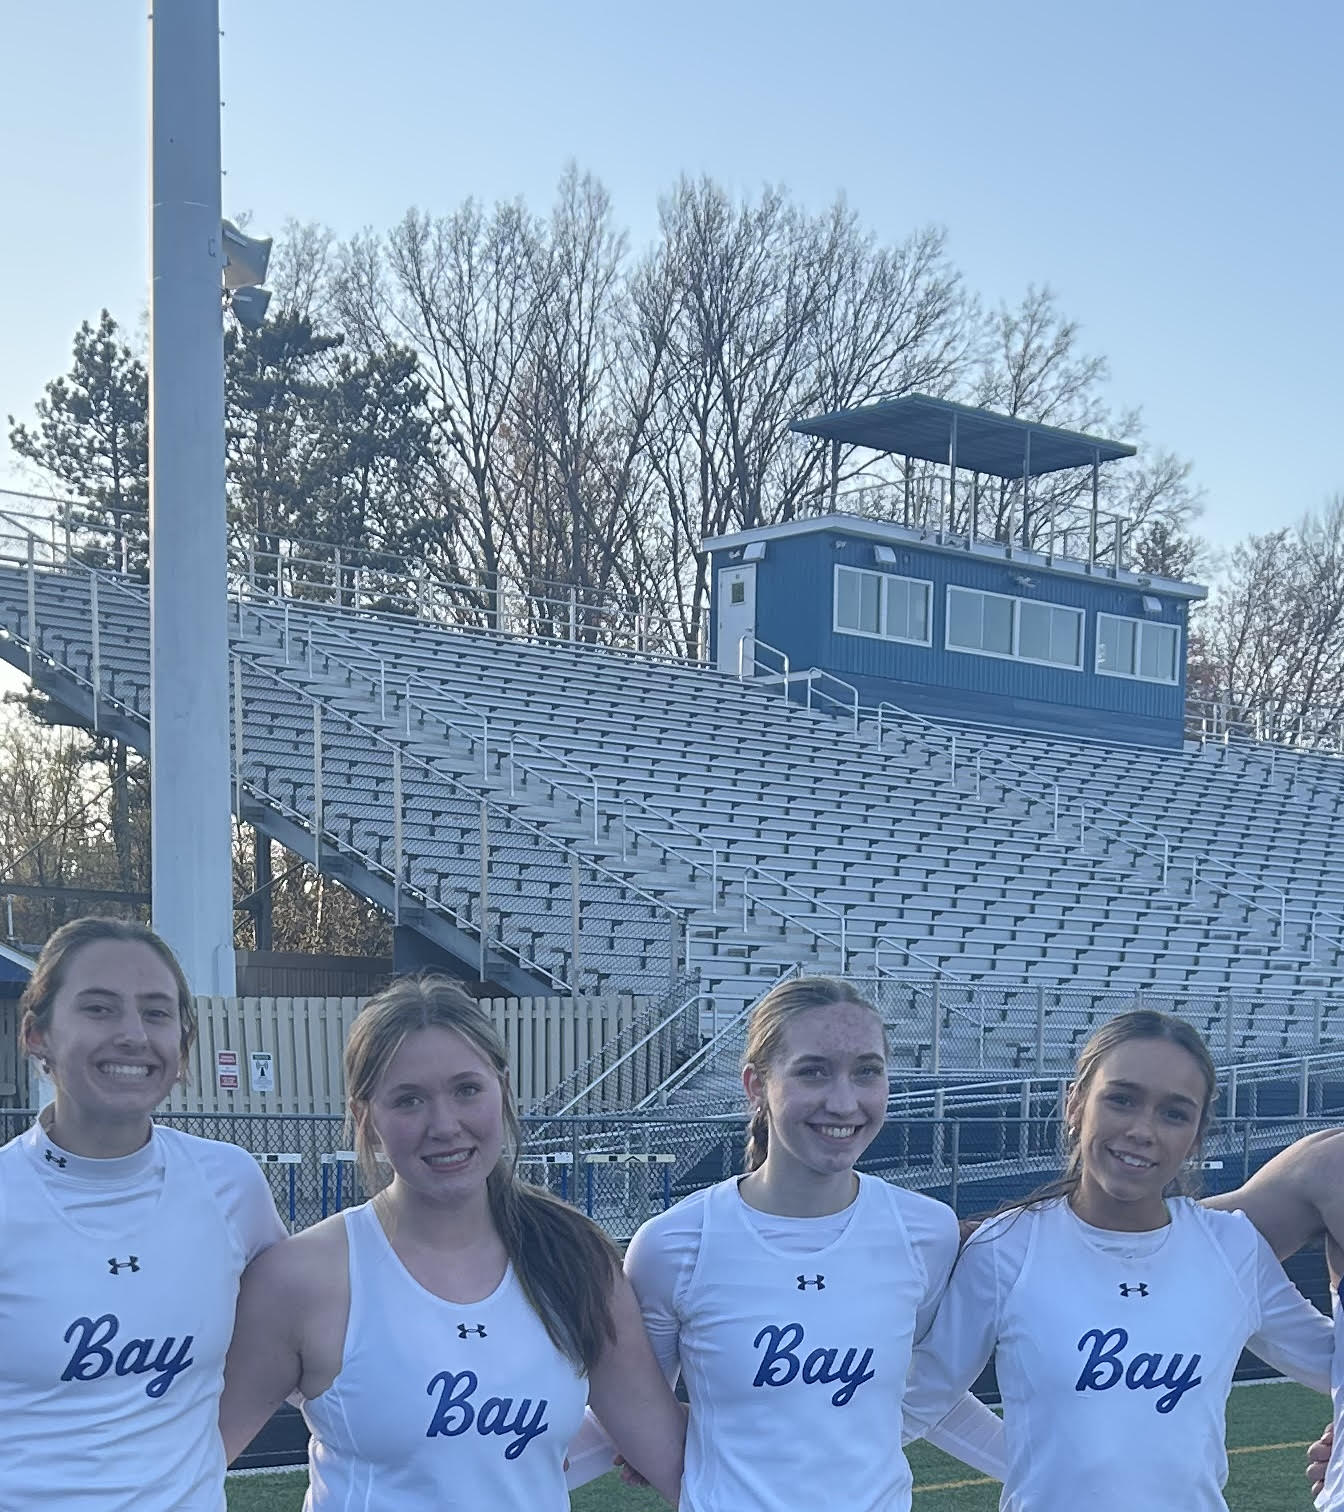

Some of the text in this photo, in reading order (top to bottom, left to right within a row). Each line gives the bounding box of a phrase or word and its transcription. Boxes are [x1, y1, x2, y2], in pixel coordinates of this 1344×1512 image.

[60, 1313, 194, 1399] Bay
[752, 1322, 876, 1408] Bay
[1075, 1327, 1203, 1414] Bay
[426, 1370, 550, 1461] Bay
